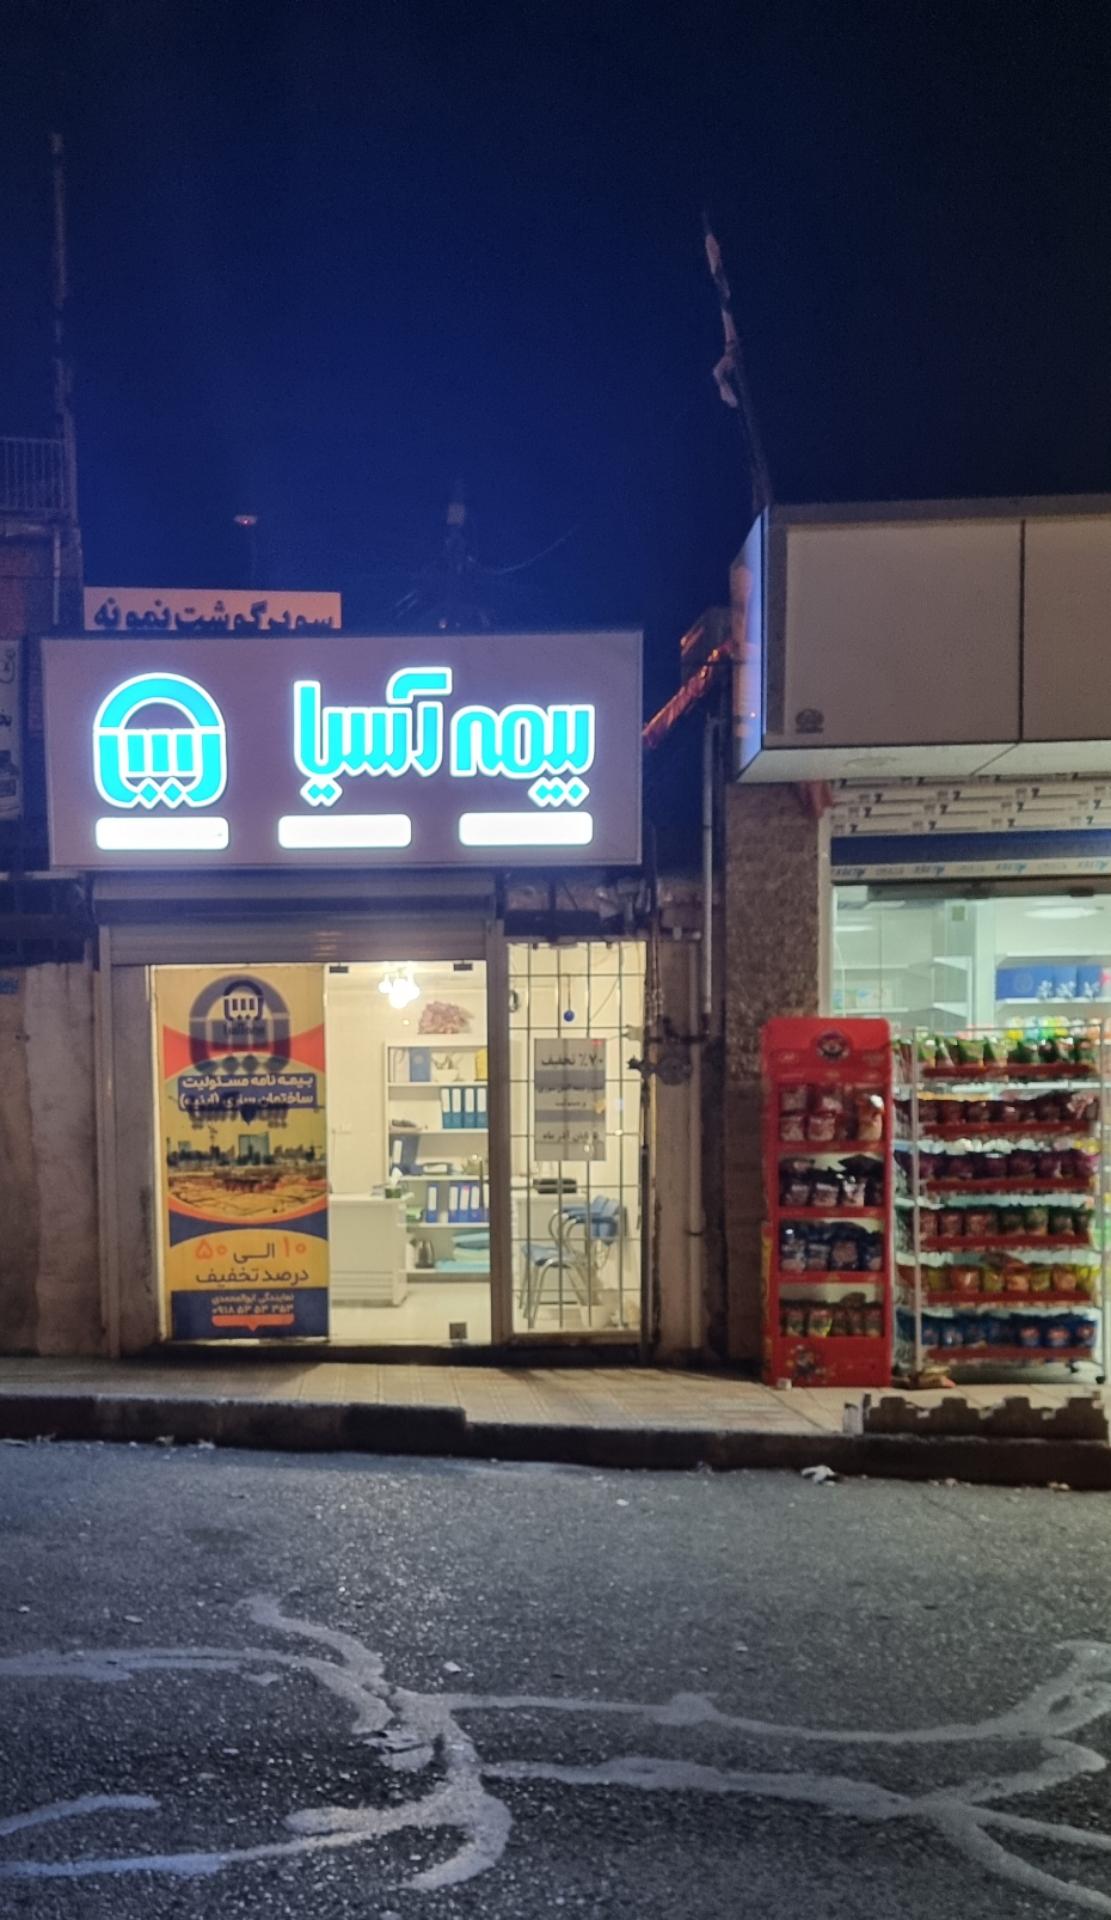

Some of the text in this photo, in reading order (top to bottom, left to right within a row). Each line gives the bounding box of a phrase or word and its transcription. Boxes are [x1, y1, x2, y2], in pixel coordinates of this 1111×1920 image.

[293, 666, 595, 807] بیمه آسیا
[250, 1073, 277, 1087] نامه
[277, 1075, 314, 1088] بیمه
[195, 1236, 307, 1264] ۱۰ الی ۵۰
[195, 1267, 310, 1289] درصد تخفیف
